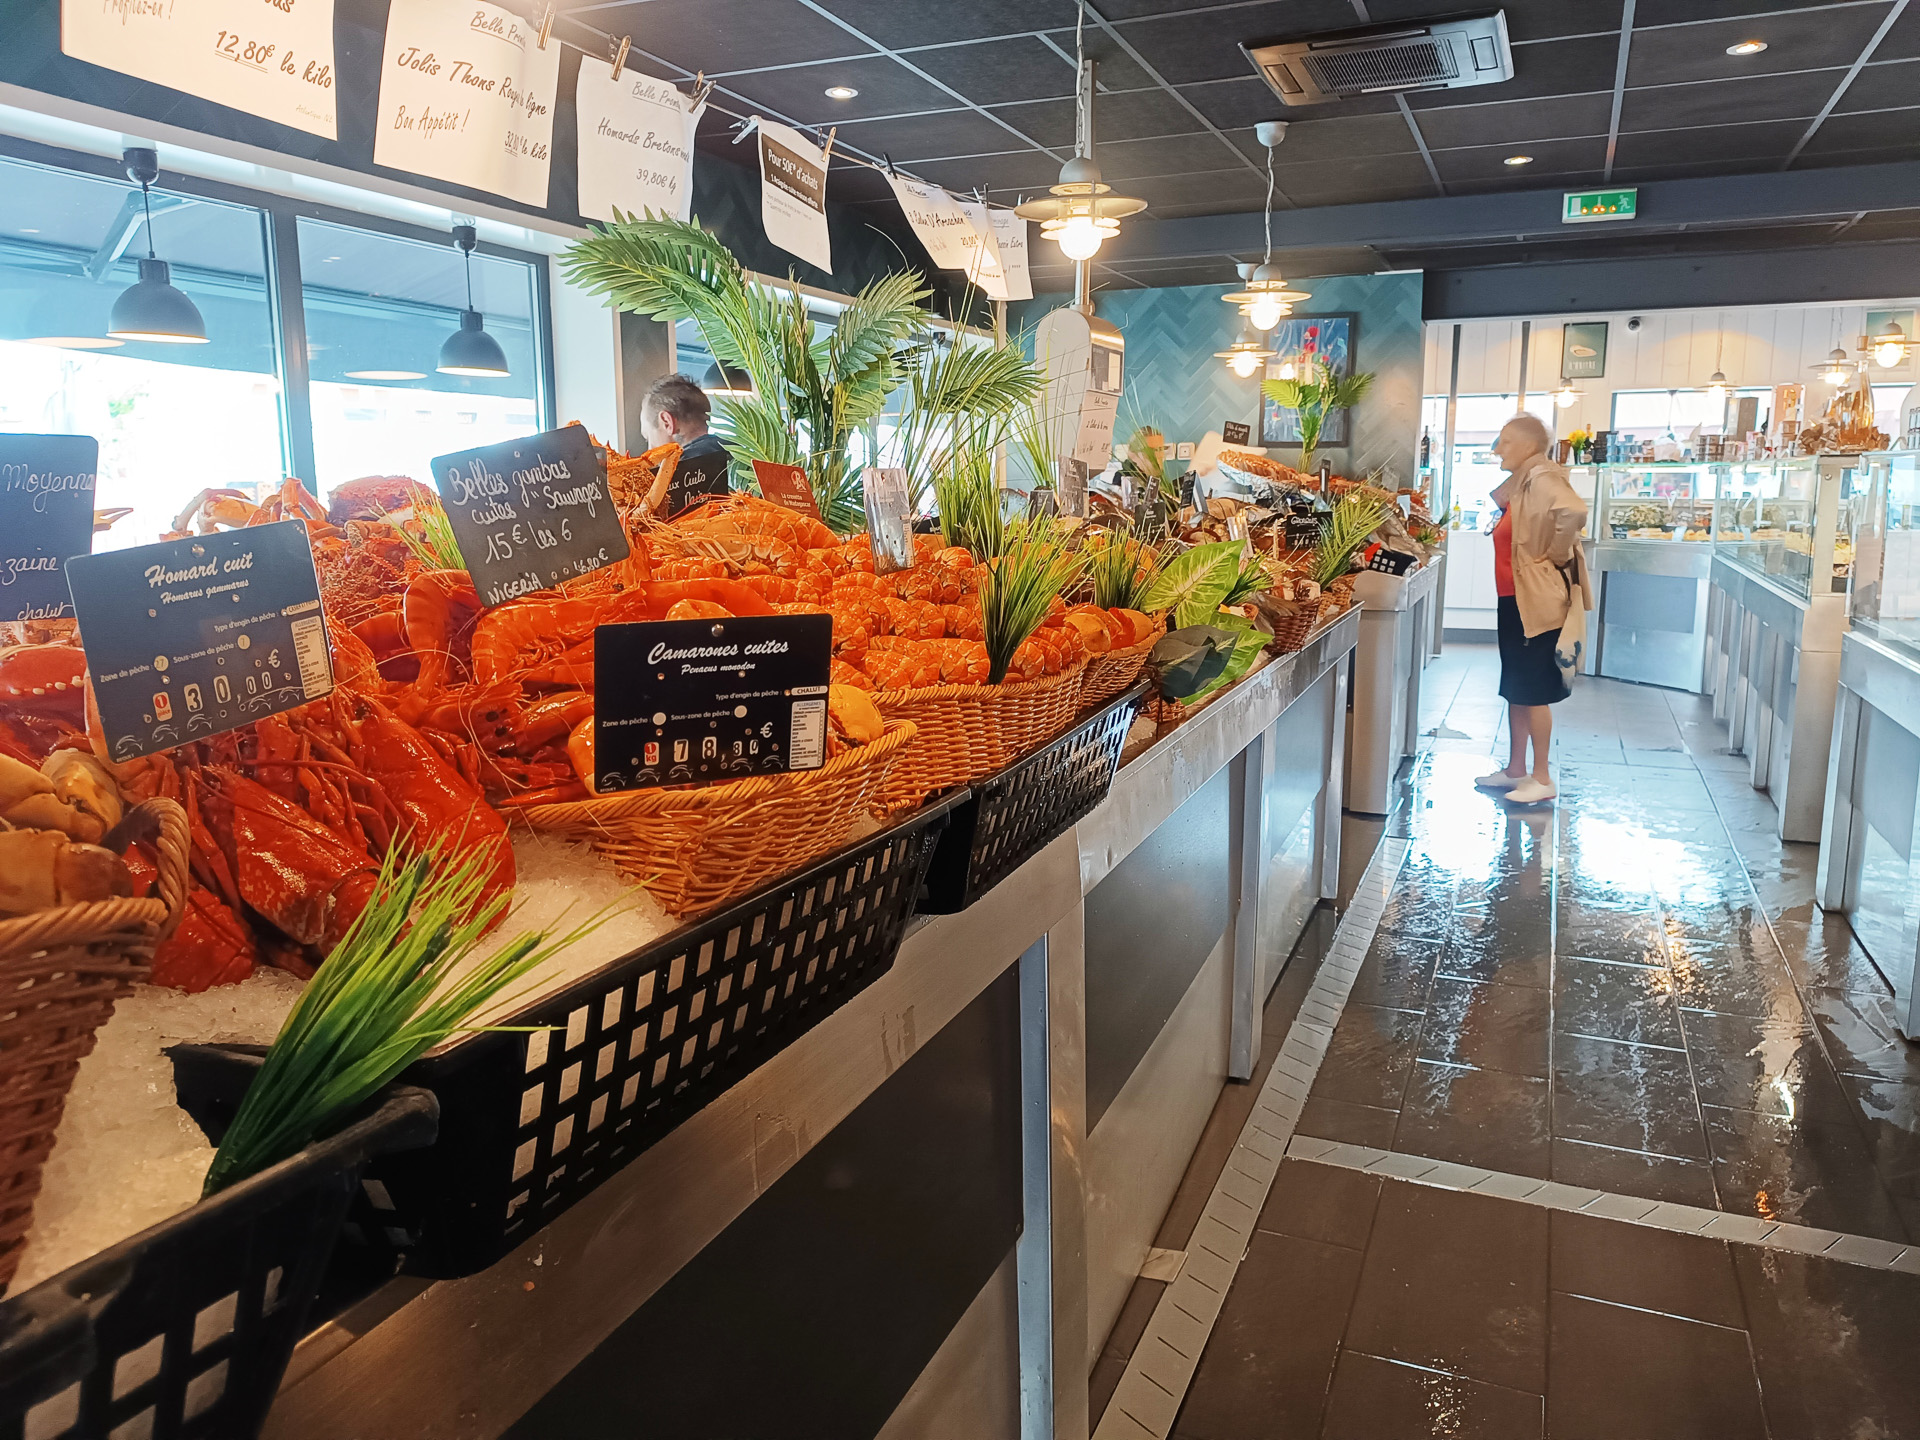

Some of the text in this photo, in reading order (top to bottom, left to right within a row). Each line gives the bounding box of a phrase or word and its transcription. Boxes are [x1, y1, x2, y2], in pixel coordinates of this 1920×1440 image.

[470, 10, 503, 34] Belle
[216, 30, 332, 88] 12,80€ le kilo
[398, 47, 441, 76] Jolis
[449, 60, 495, 92] Thons
[525, 91, 547, 119] ligne
[632, 81, 656, 100] Belle
[394, 104, 414, 130] Bon
[598, 117, 640, 145] Homards
[643, 131, 680, 157] Bretons
[530, 142, 547, 160] kilo
[768, 148, 782, 168] Pour
[448, 458, 509, 506] Belles
[472, 497, 517, 525] cuites
[528, 520, 558, 549] les
[561, 518, 572, 541] 6
[145, 552, 253, 588] Homard cuit
[160, 579, 249, 605] Homarus gammarus
[214, 624, 228, 633] Type
[228, 618, 250, 629] d'engin
[250, 615, 259, 623] de
[173, 650, 206, 664] Sous-zone
[206, 647, 216, 655] de
[647, 640, 790, 665] Camarones cuites
[100, 674, 118, 683] Zone
[119, 670, 129, 678] de
[720, 661, 756, 672] monodon
[671, 712, 702, 721] Sous-zone
[646, 754, 657, 763] kg
